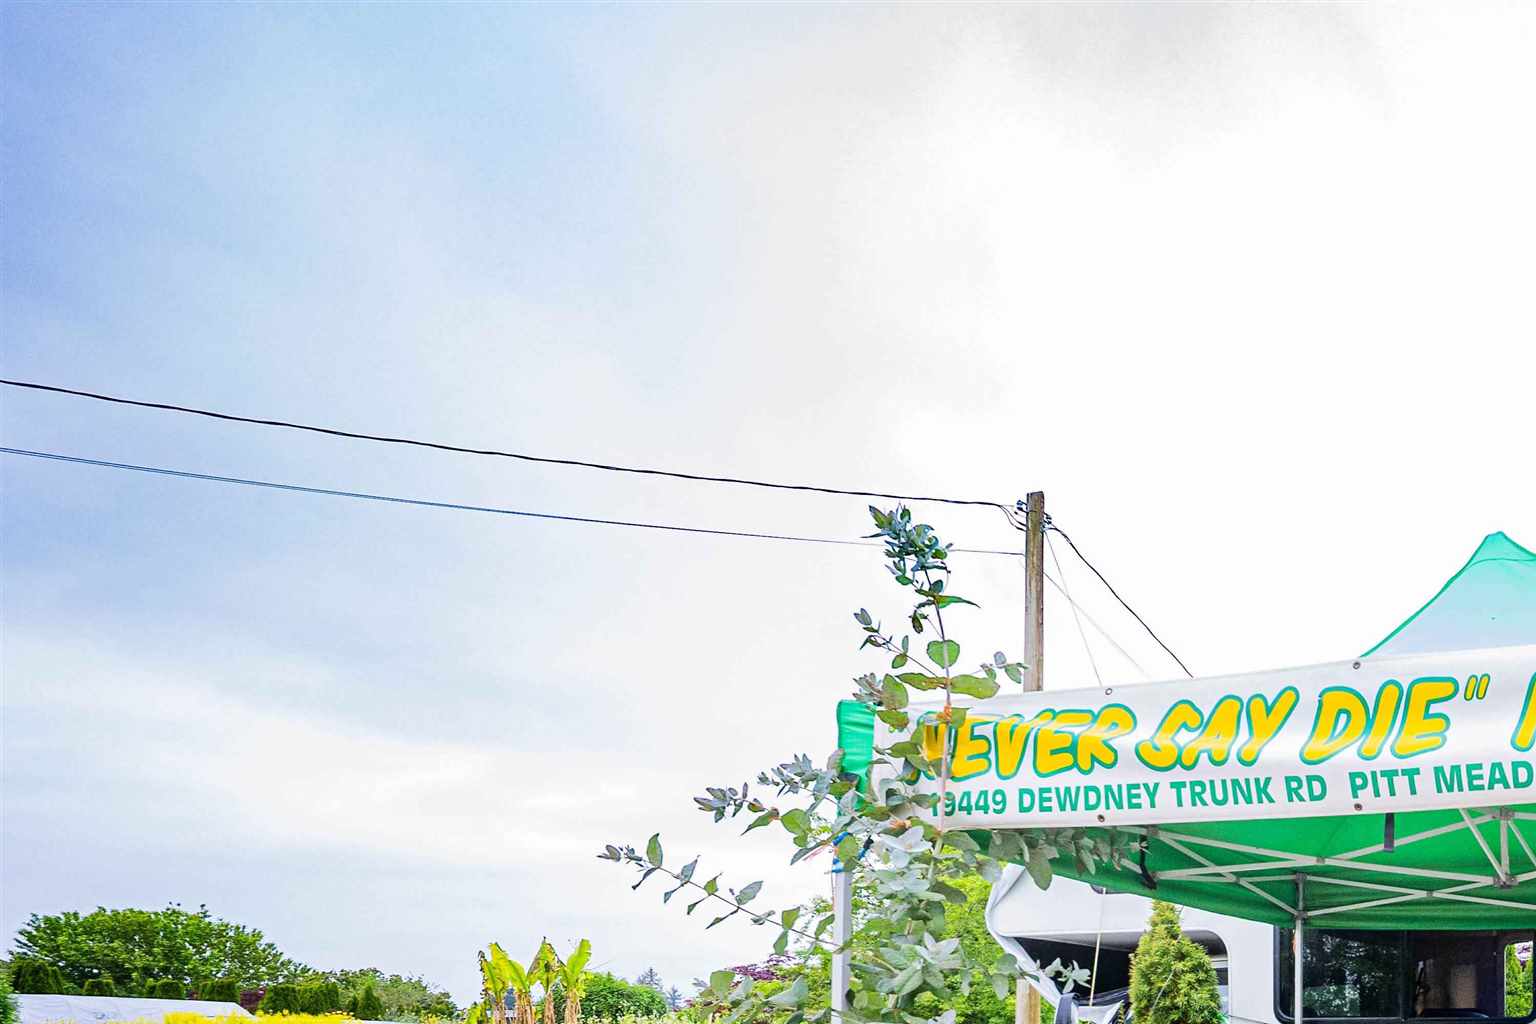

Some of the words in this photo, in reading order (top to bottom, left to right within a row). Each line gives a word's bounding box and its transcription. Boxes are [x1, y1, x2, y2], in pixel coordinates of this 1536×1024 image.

[1135, 685, 1300, 773] SAY
[1018, 783, 1160, 815] DEWDNEY
[1169, 776, 1276, 807] TRUNK
[1284, 774, 1328, 803] RD
[1348, 767, 1421, 800] PITT
